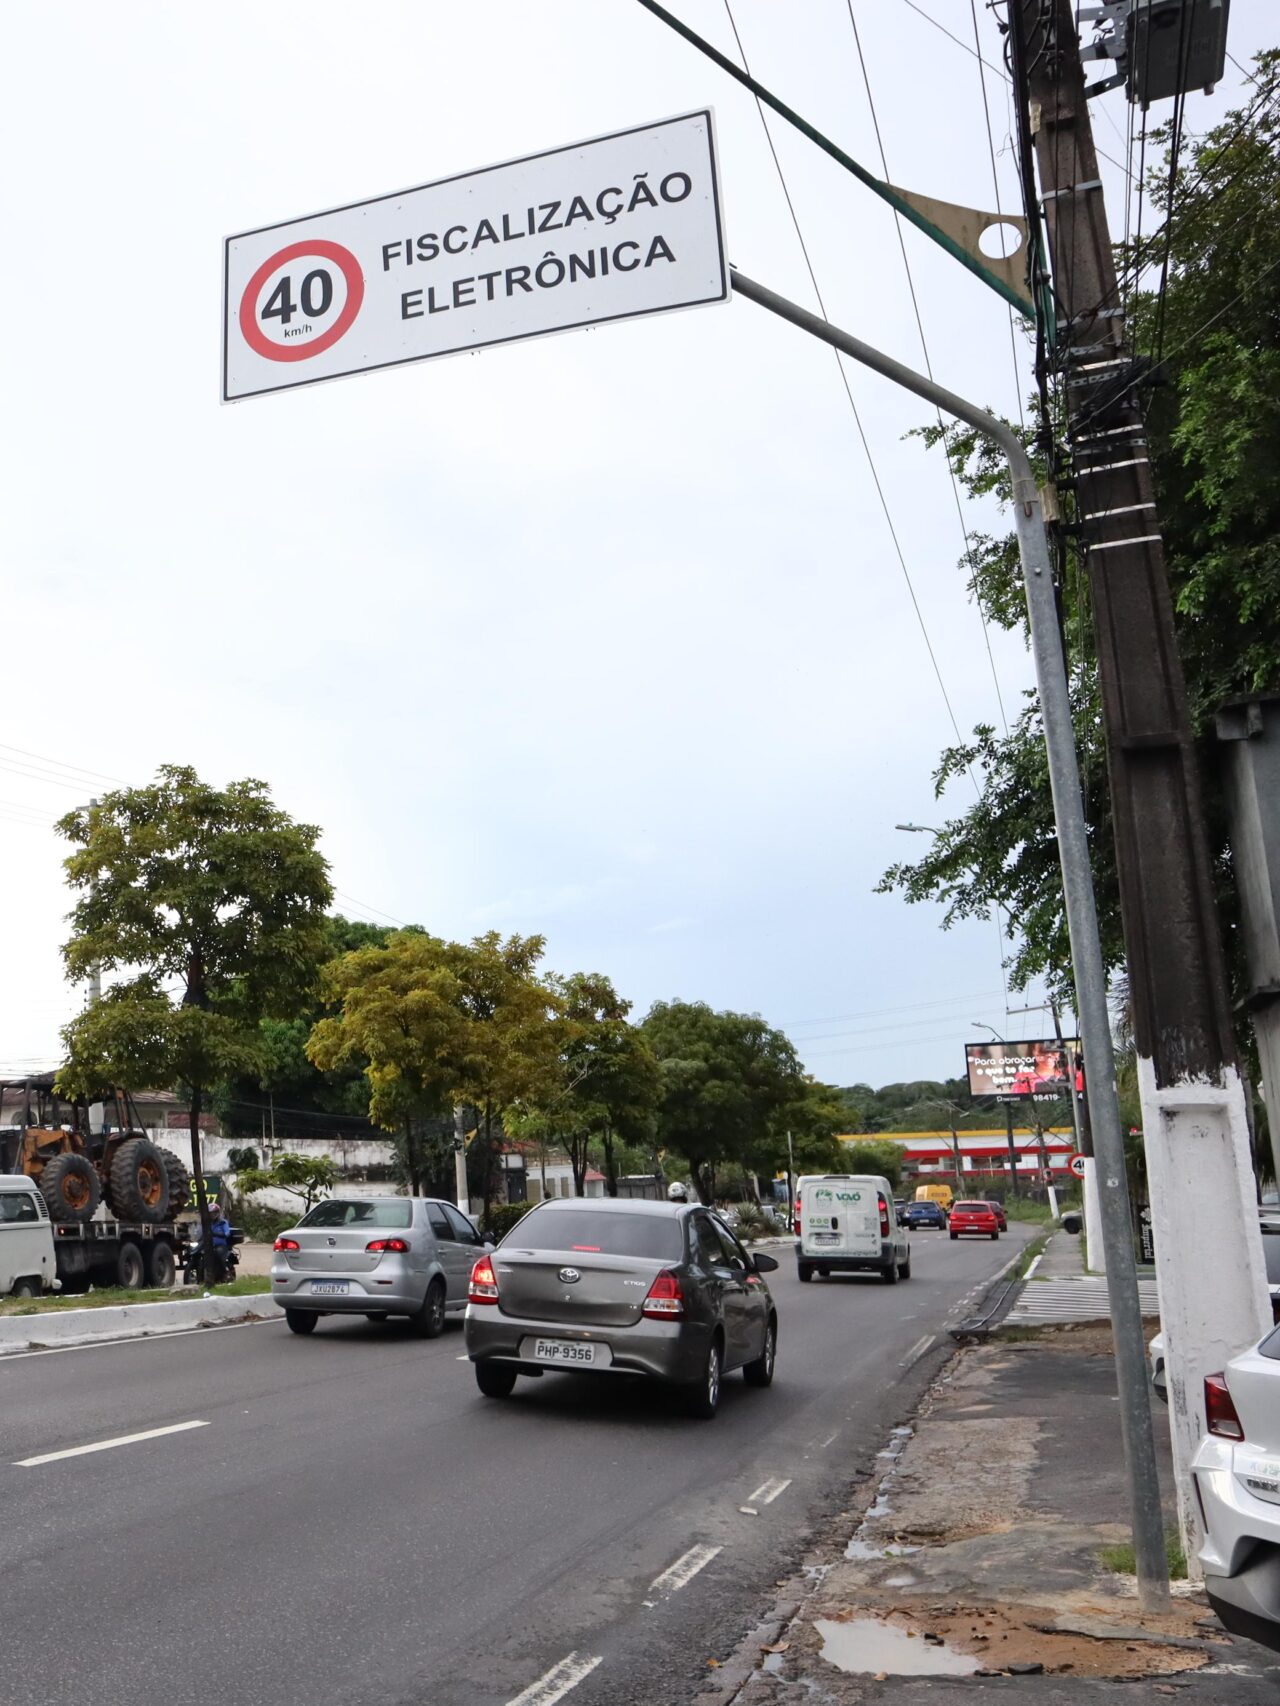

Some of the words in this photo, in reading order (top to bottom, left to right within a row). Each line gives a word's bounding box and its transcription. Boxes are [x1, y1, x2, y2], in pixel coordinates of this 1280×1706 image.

[381, 171, 693, 271] FISCALIZAÇÃO
[400, 235, 677, 320] ELETRÔNICA
[261, 269, 333, 324] 40
[284, 323, 313, 338] km/h
[974, 1057, 996, 1066] Para
[999, 1056, 1036, 1066] abraçar
[985, 1067, 1004, 1077] que
[1073, 1159, 1085, 1170] 4
[537, 1345, 592, 1361] PHP-9356
